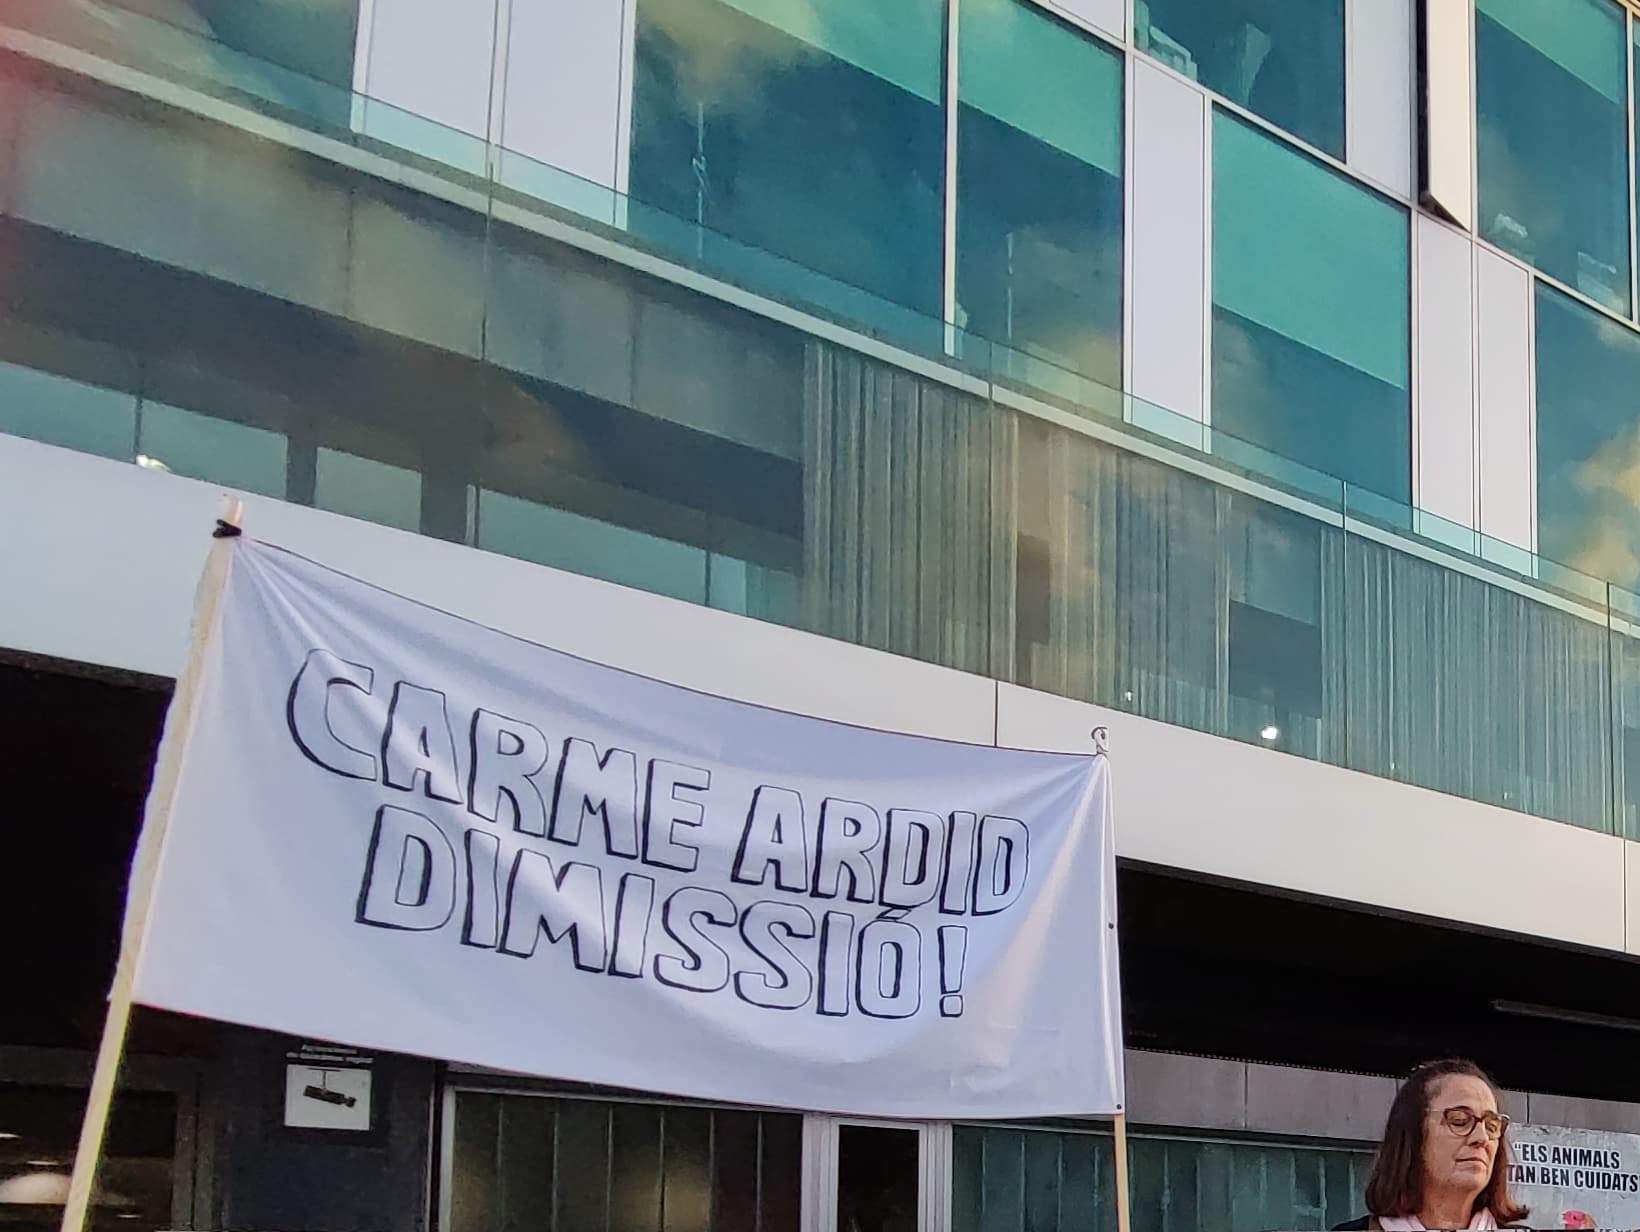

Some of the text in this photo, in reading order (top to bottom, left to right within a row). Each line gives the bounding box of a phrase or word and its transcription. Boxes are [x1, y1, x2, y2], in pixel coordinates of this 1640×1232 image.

[286, 648, 1030, 917] CARME ARDID
[354, 804, 968, 1019] DIMISSIÓ!
[1540, 1166, 1570, 1186] BEN
[1551, 1146, 1620, 1169] ANIMALS
